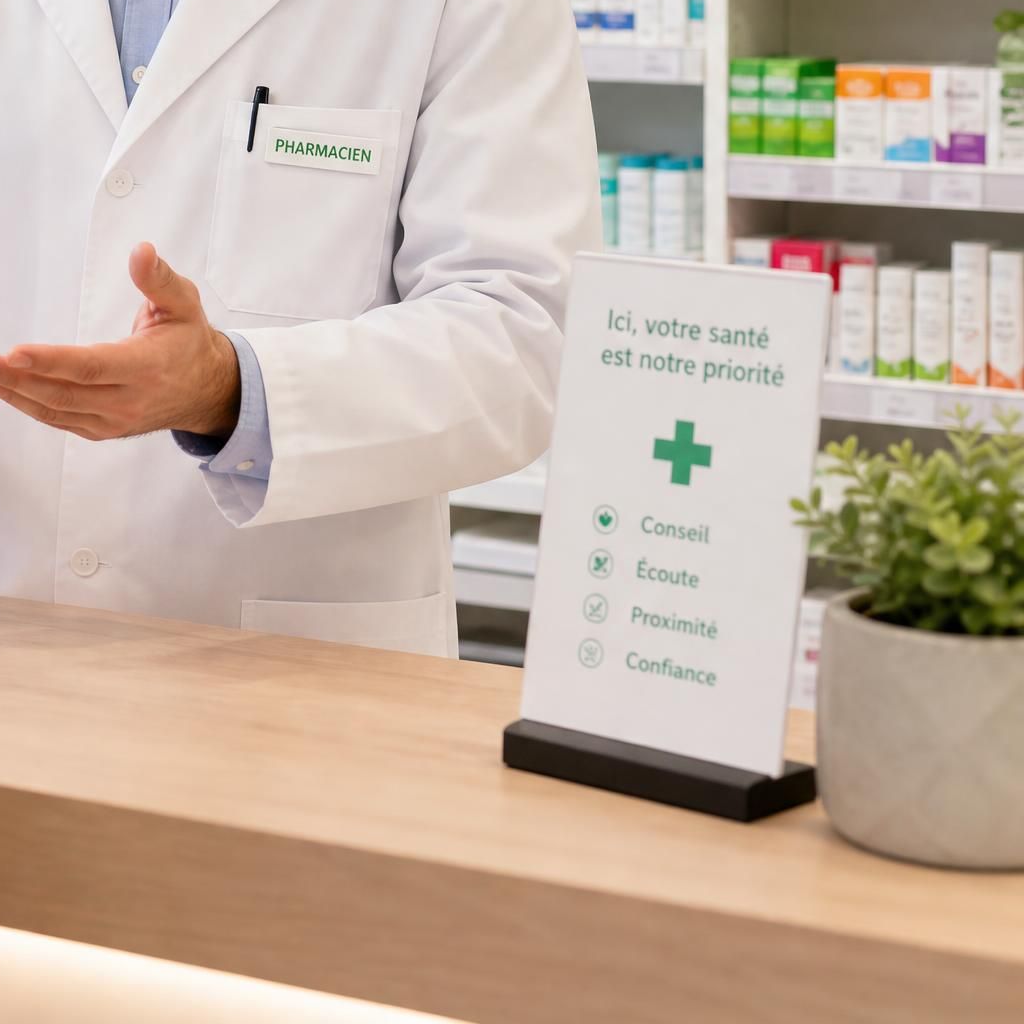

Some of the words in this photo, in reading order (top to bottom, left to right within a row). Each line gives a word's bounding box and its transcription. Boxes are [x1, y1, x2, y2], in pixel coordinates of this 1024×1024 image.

[275, 139, 371, 163] PHARMACIEN
[608, 309, 637, 336] Ici,
[645, 319, 701, 342] votre
[709, 326, 769, 350] santé
[601, 347, 633, 368] est
[640, 353, 696, 376] notre
[703, 358, 784, 387] priorité
[641, 516, 710, 544] Conseil
[637, 558, 700, 589] Écoute
[631, 606, 718, 640] Proximité
[626, 651, 717, 686] Confiance
